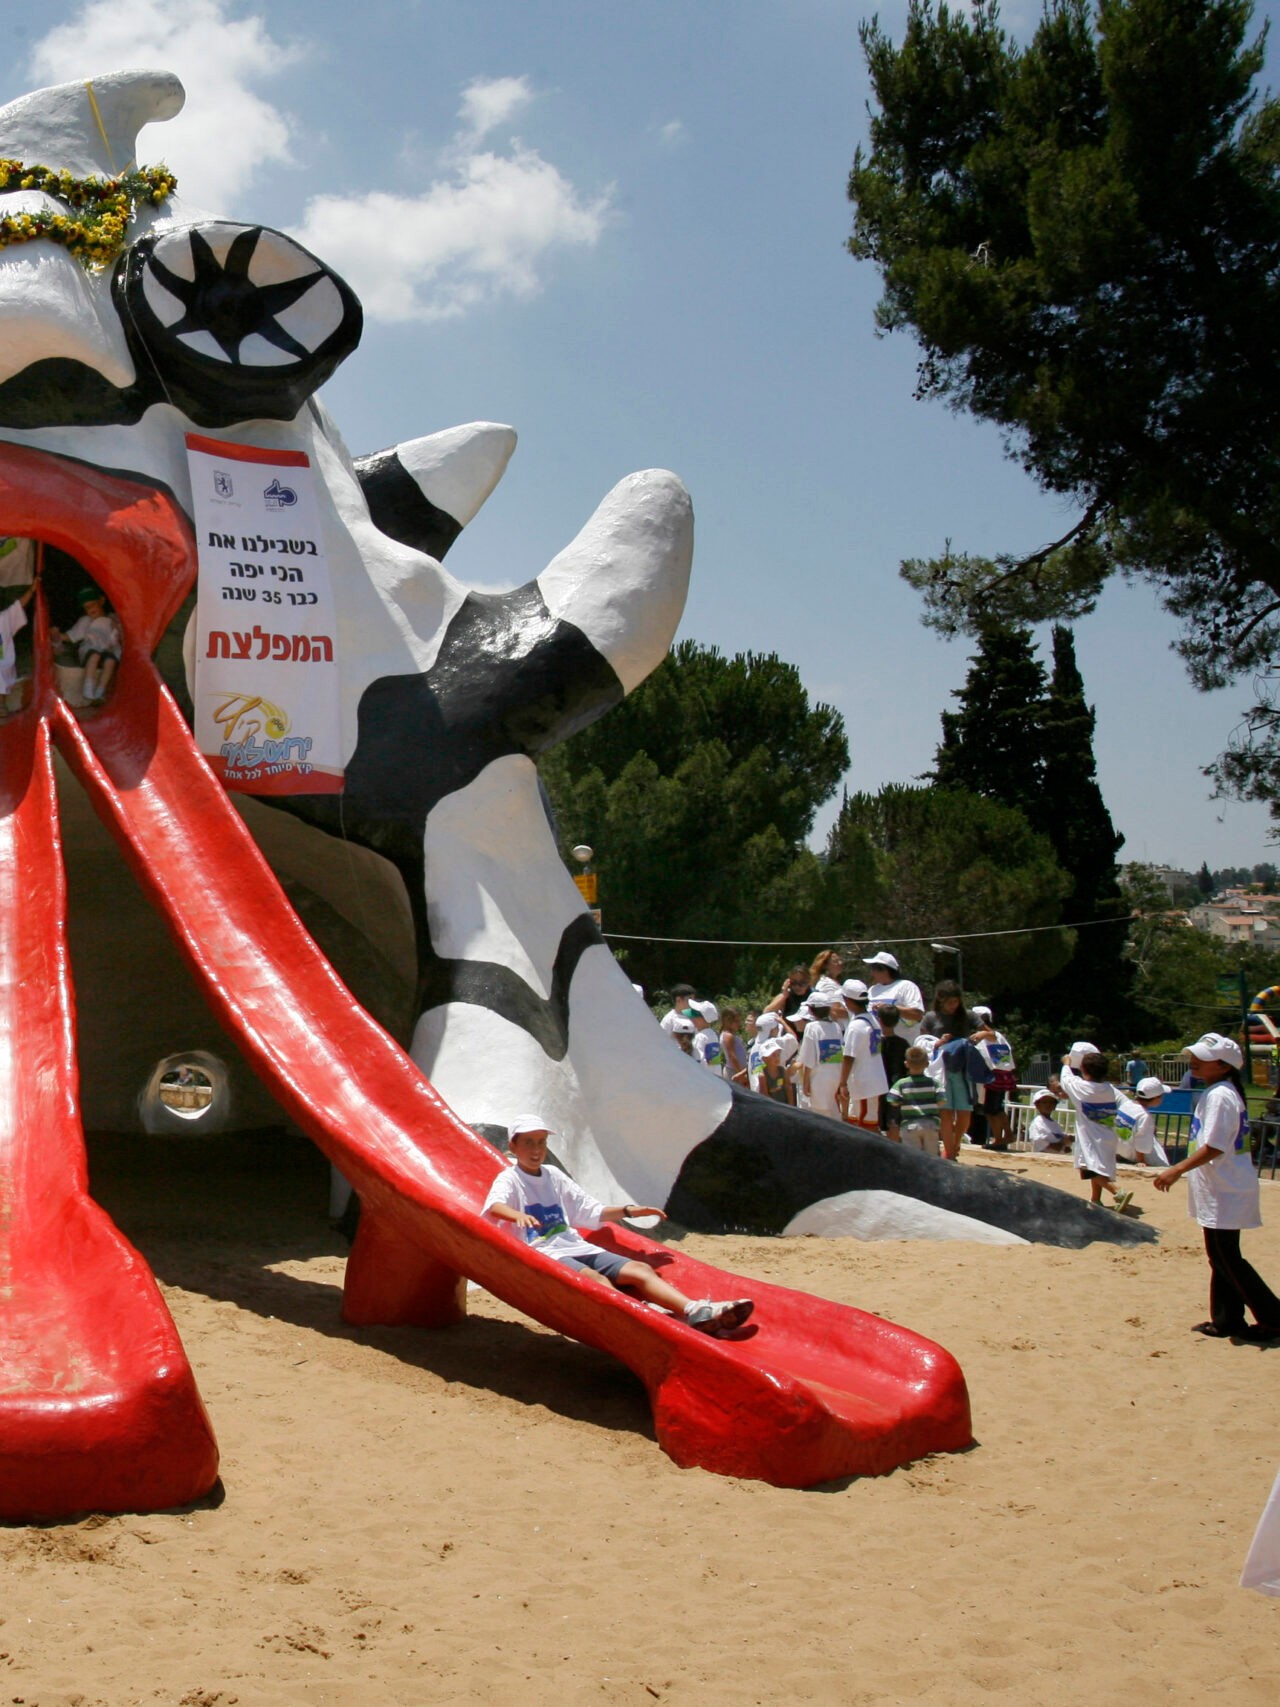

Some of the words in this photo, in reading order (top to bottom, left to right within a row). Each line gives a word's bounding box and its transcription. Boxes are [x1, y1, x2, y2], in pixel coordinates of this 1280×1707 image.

[208, 532, 236, 550] את
[242, 535, 318, 556] בשבילנו
[230, 562, 265, 578] יפה
[270, 565, 304, 583] הכי
[222, 586, 257, 601] שנה
[262, 590, 282, 604] 35
[287, 592, 318, 606] כבר
[206, 625, 334, 662] המפלצת
[223, 769, 243, 780] אחד
[245, 768, 262, 780] לכל
[265, 763, 294, 776] מיוחד
[296, 762, 313, 775] קיץ
